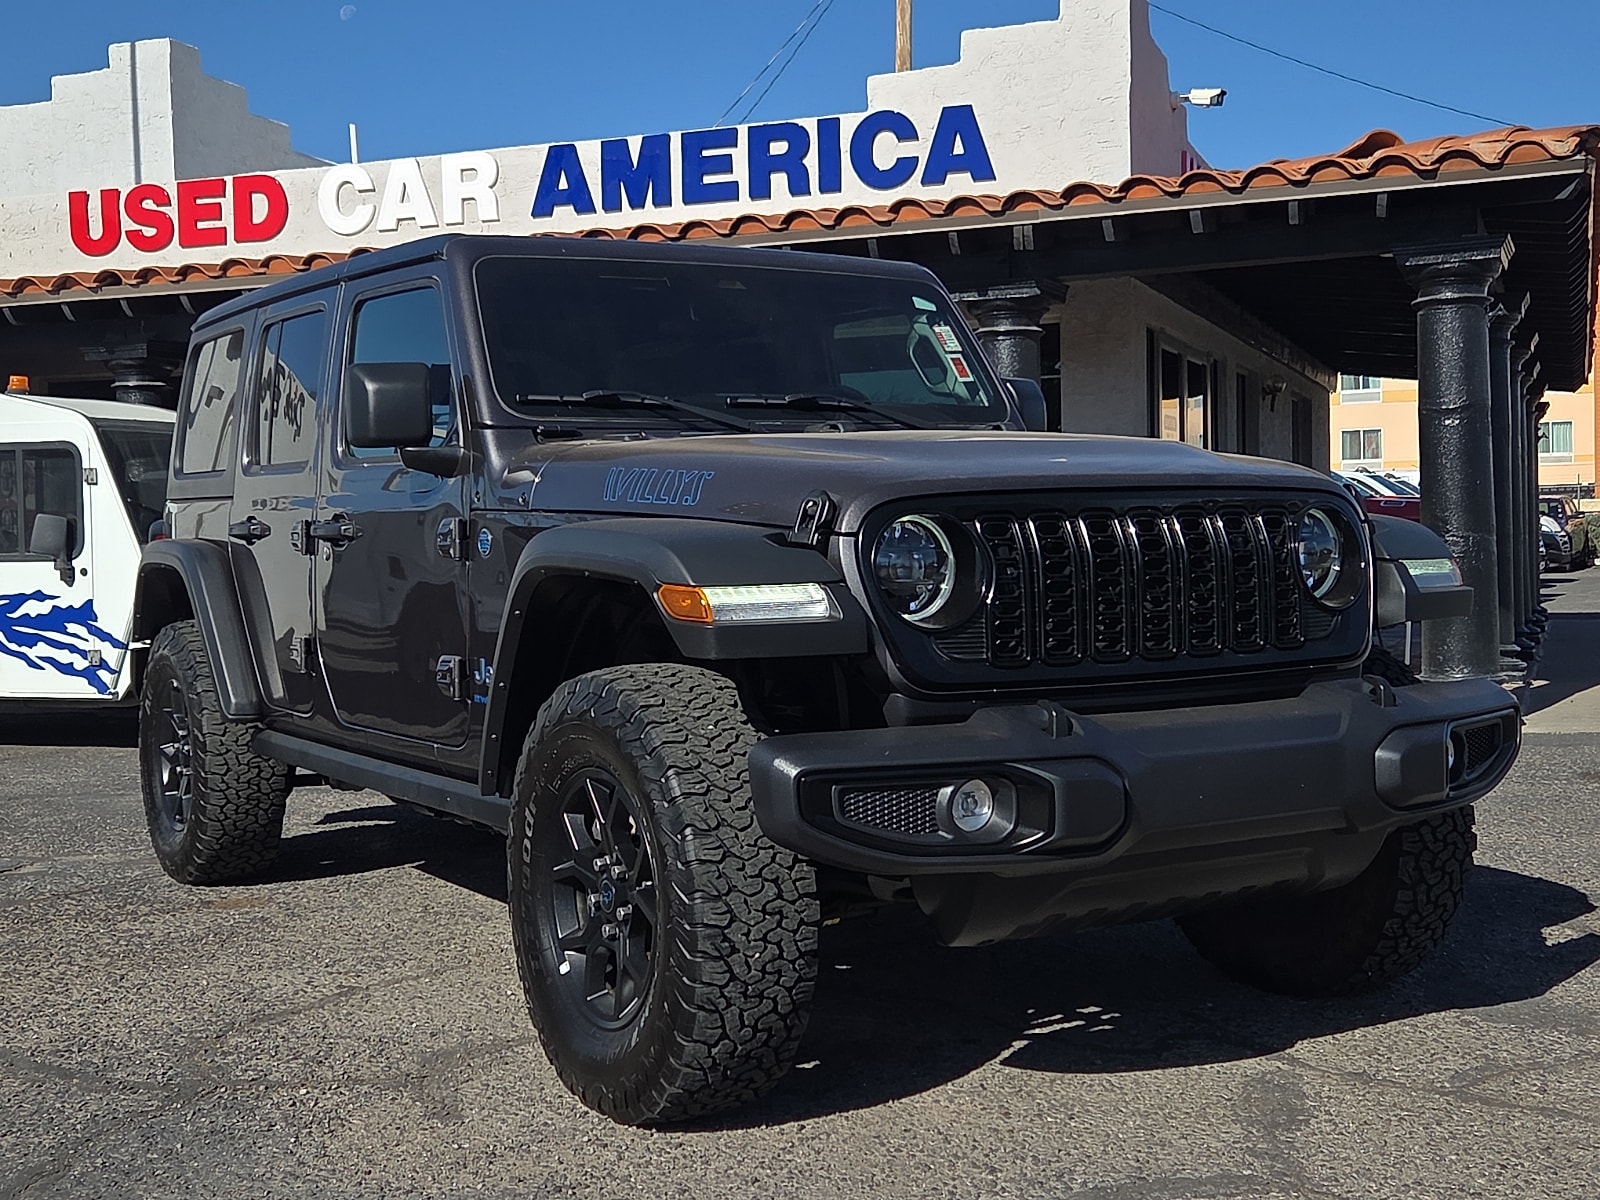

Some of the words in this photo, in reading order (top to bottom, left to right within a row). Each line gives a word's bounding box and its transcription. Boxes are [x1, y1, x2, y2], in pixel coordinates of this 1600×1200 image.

[68, 174, 289, 258] USED
[318, 152, 501, 237] CAR
[530, 104, 997, 219] AMERICA
[603, 467, 716, 506] WILLYS
